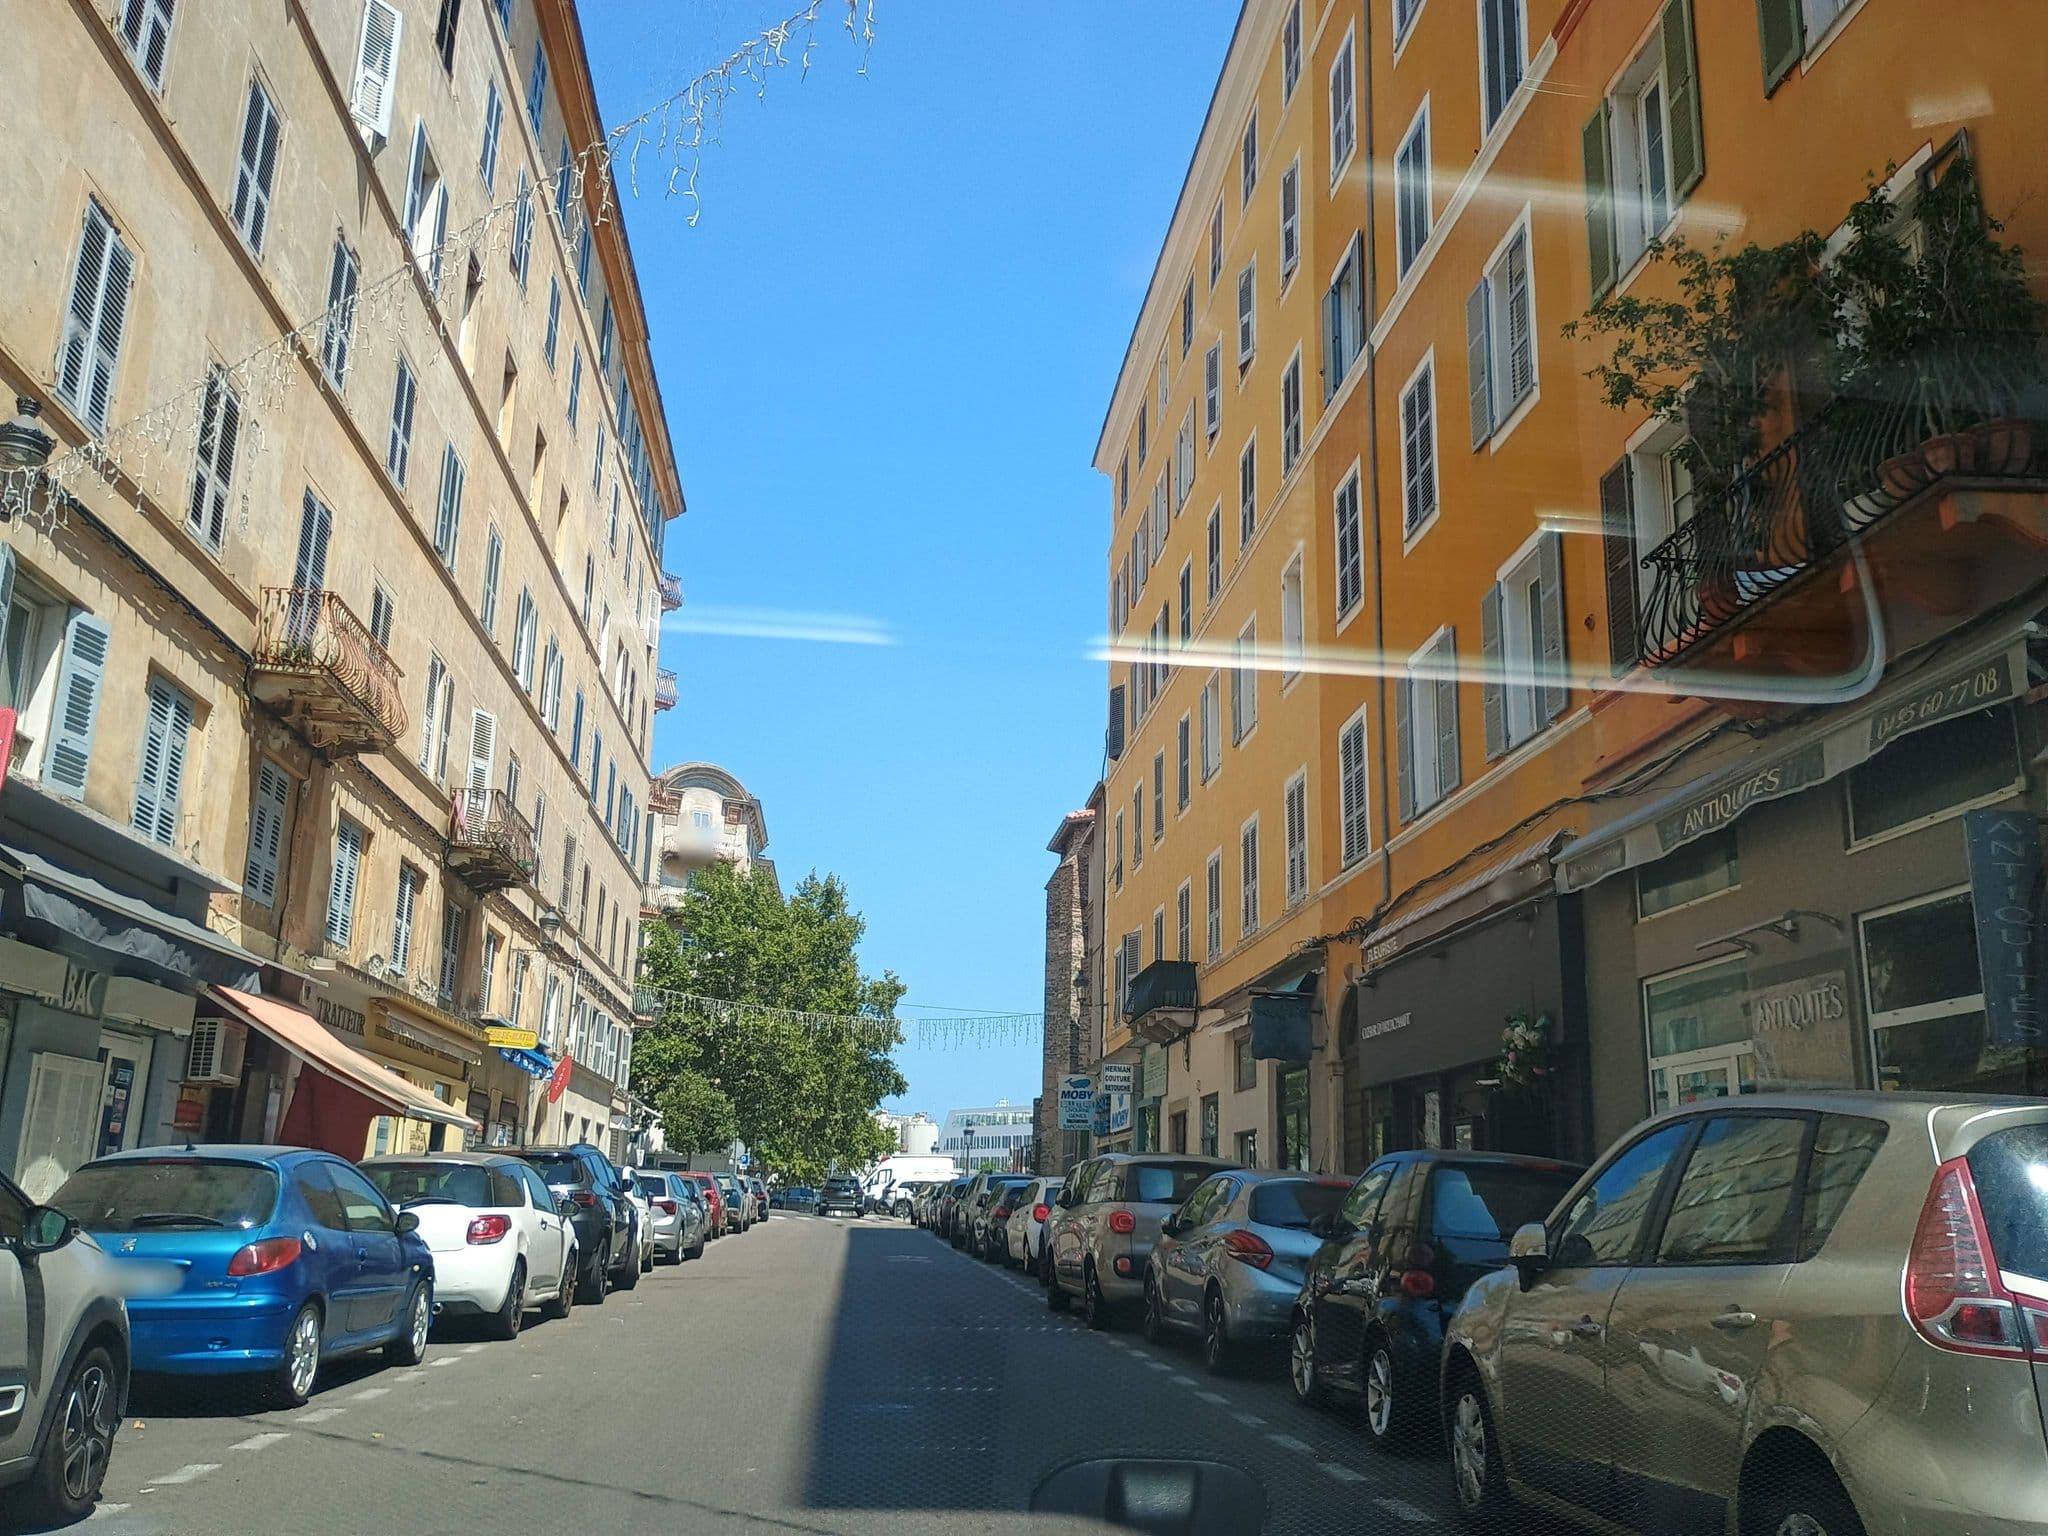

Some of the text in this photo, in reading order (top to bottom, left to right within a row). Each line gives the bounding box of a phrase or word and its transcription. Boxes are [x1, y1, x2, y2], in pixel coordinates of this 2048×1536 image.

[317, 997, 365, 1036] TRAITEUR
[1104, 1065, 1131, 1073] HERMAN
[1104, 1075, 1131, 1083] COUTURE
[1061, 1090, 1094, 1099] MOBY
[1111, 1109, 1129, 1129] MOBY
